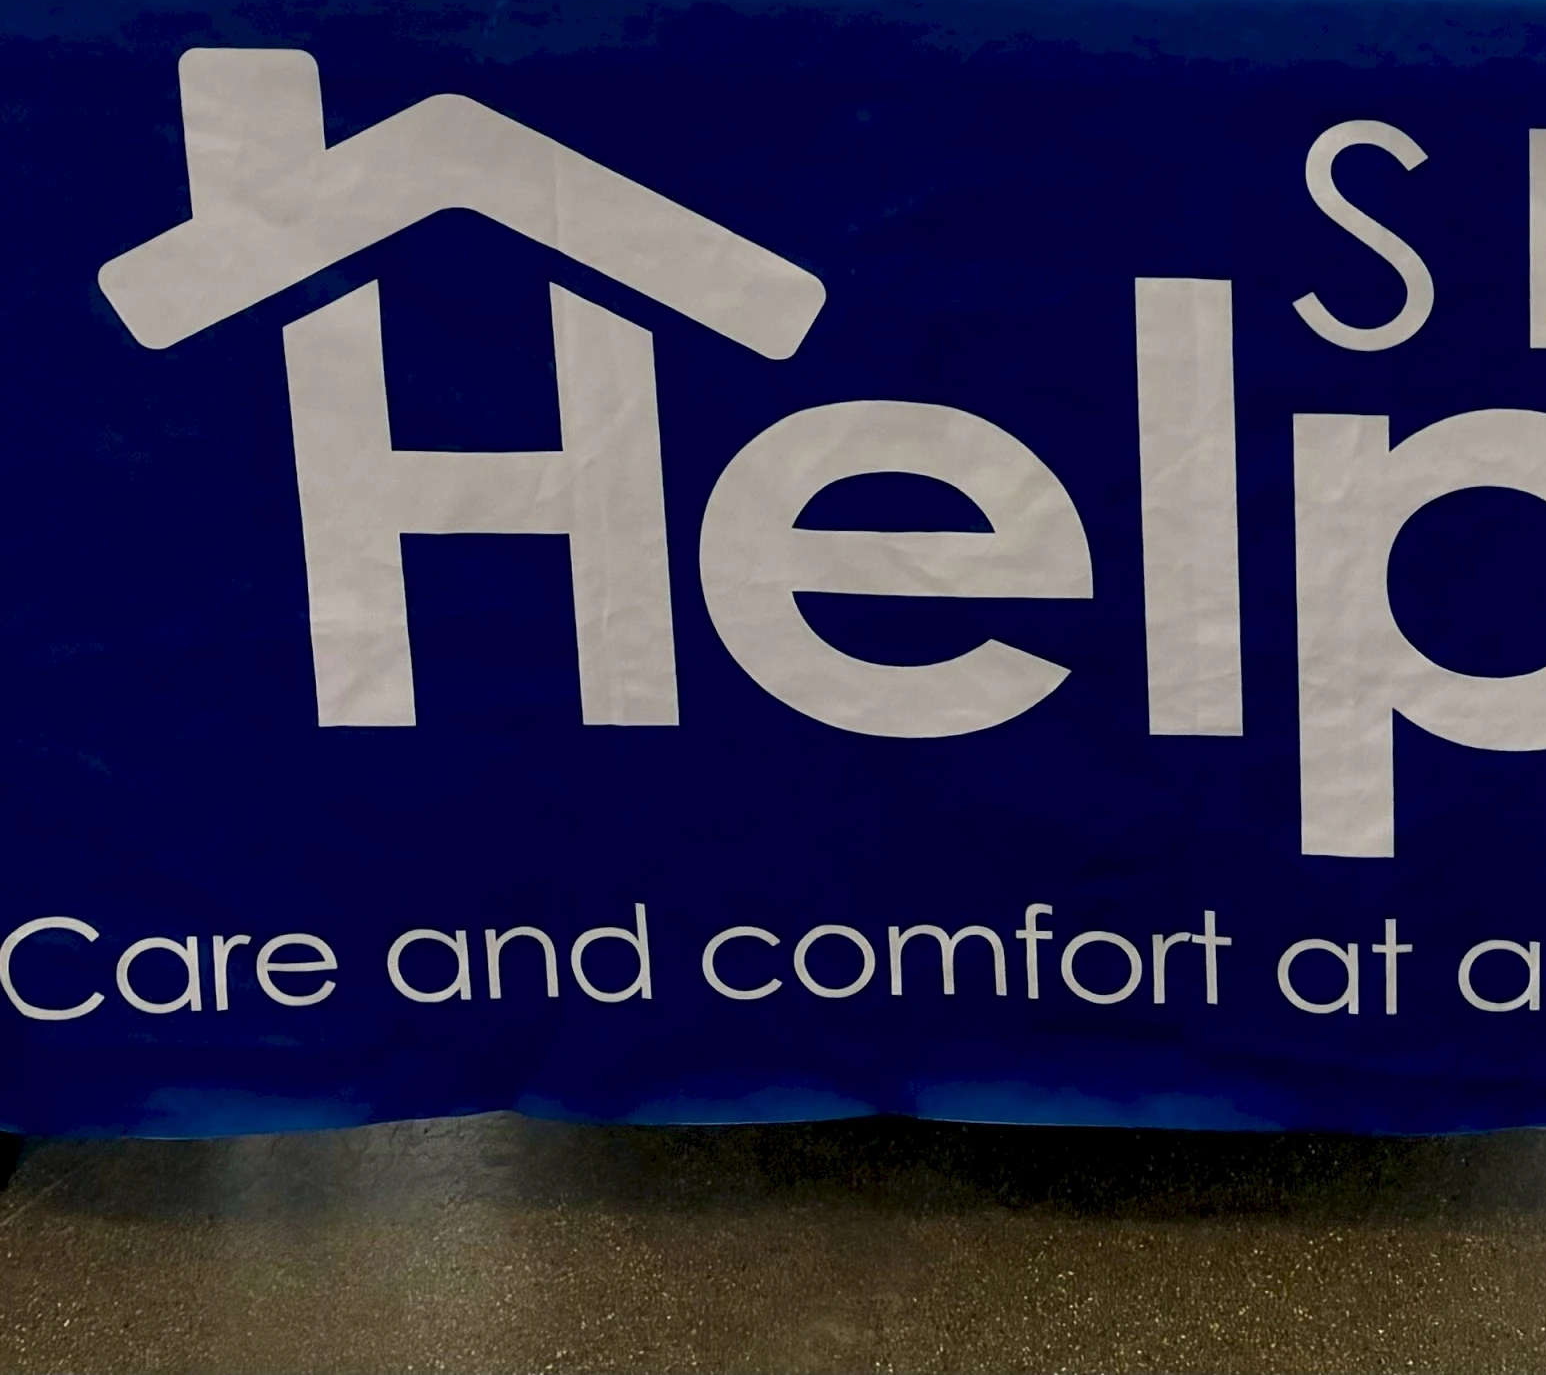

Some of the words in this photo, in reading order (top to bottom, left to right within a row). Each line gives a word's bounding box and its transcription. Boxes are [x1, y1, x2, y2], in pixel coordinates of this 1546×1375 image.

[0, 916, 339, 1022] Care
[386, 902, 655, 1003] and
[701, 902, 1234, 1009] comfort
[1276, 917, 1414, 1016] at
[1456, 939, 1541, 1012] a
